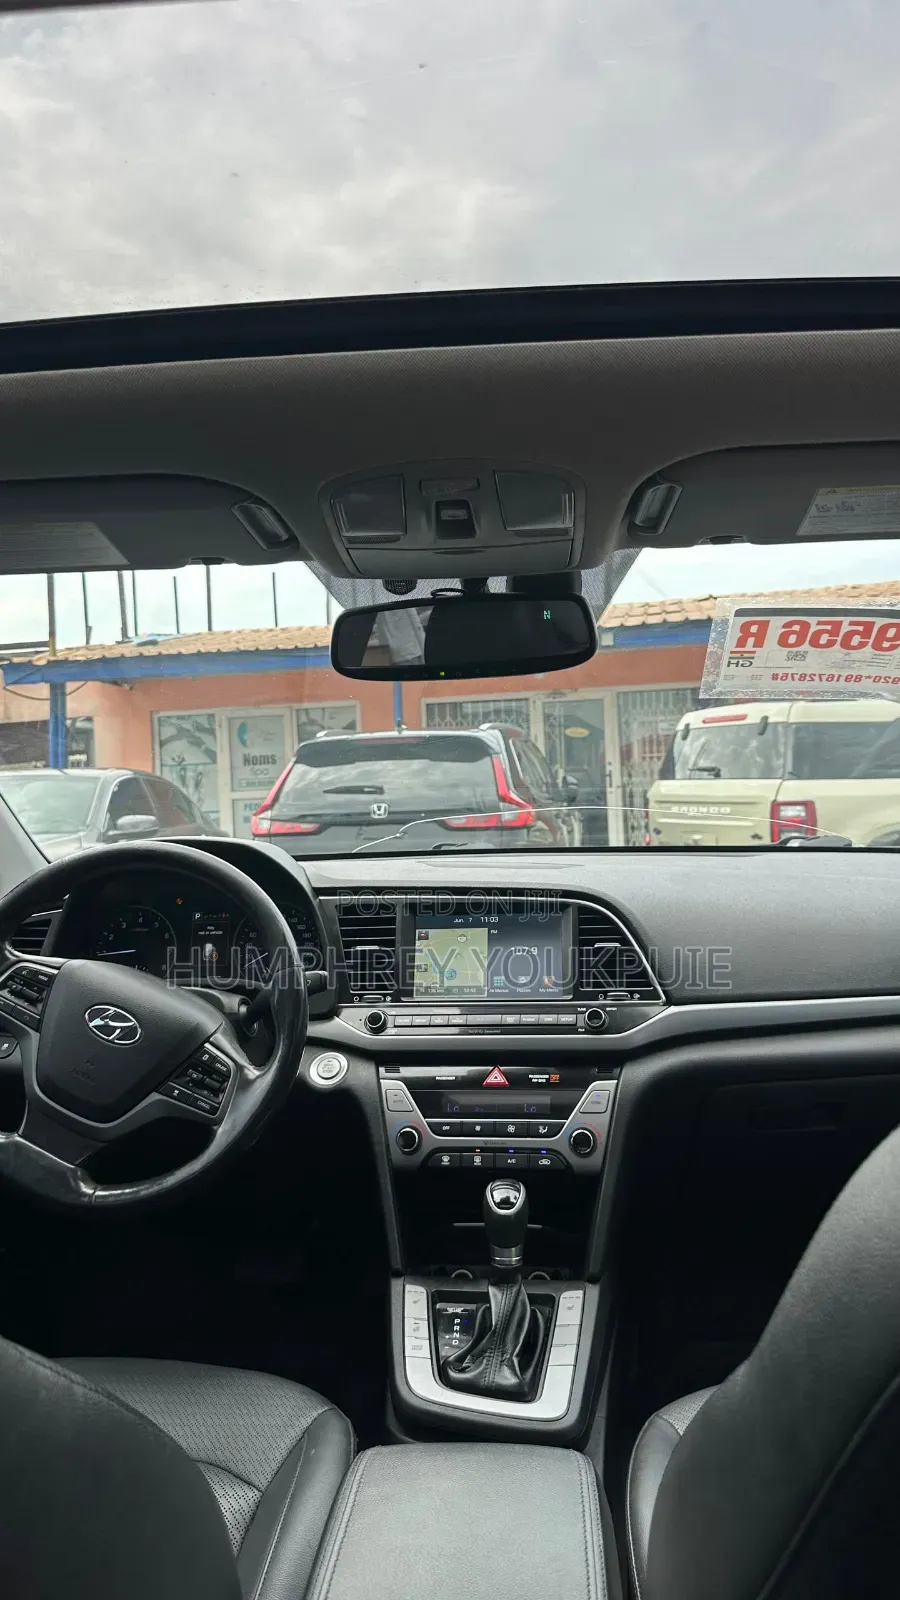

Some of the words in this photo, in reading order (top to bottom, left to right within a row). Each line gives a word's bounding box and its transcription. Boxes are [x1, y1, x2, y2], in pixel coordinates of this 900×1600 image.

[543, 609, 551, 620] N
[194, 912, 201, 920] P
[510, 946, 538, 956] 107.9
